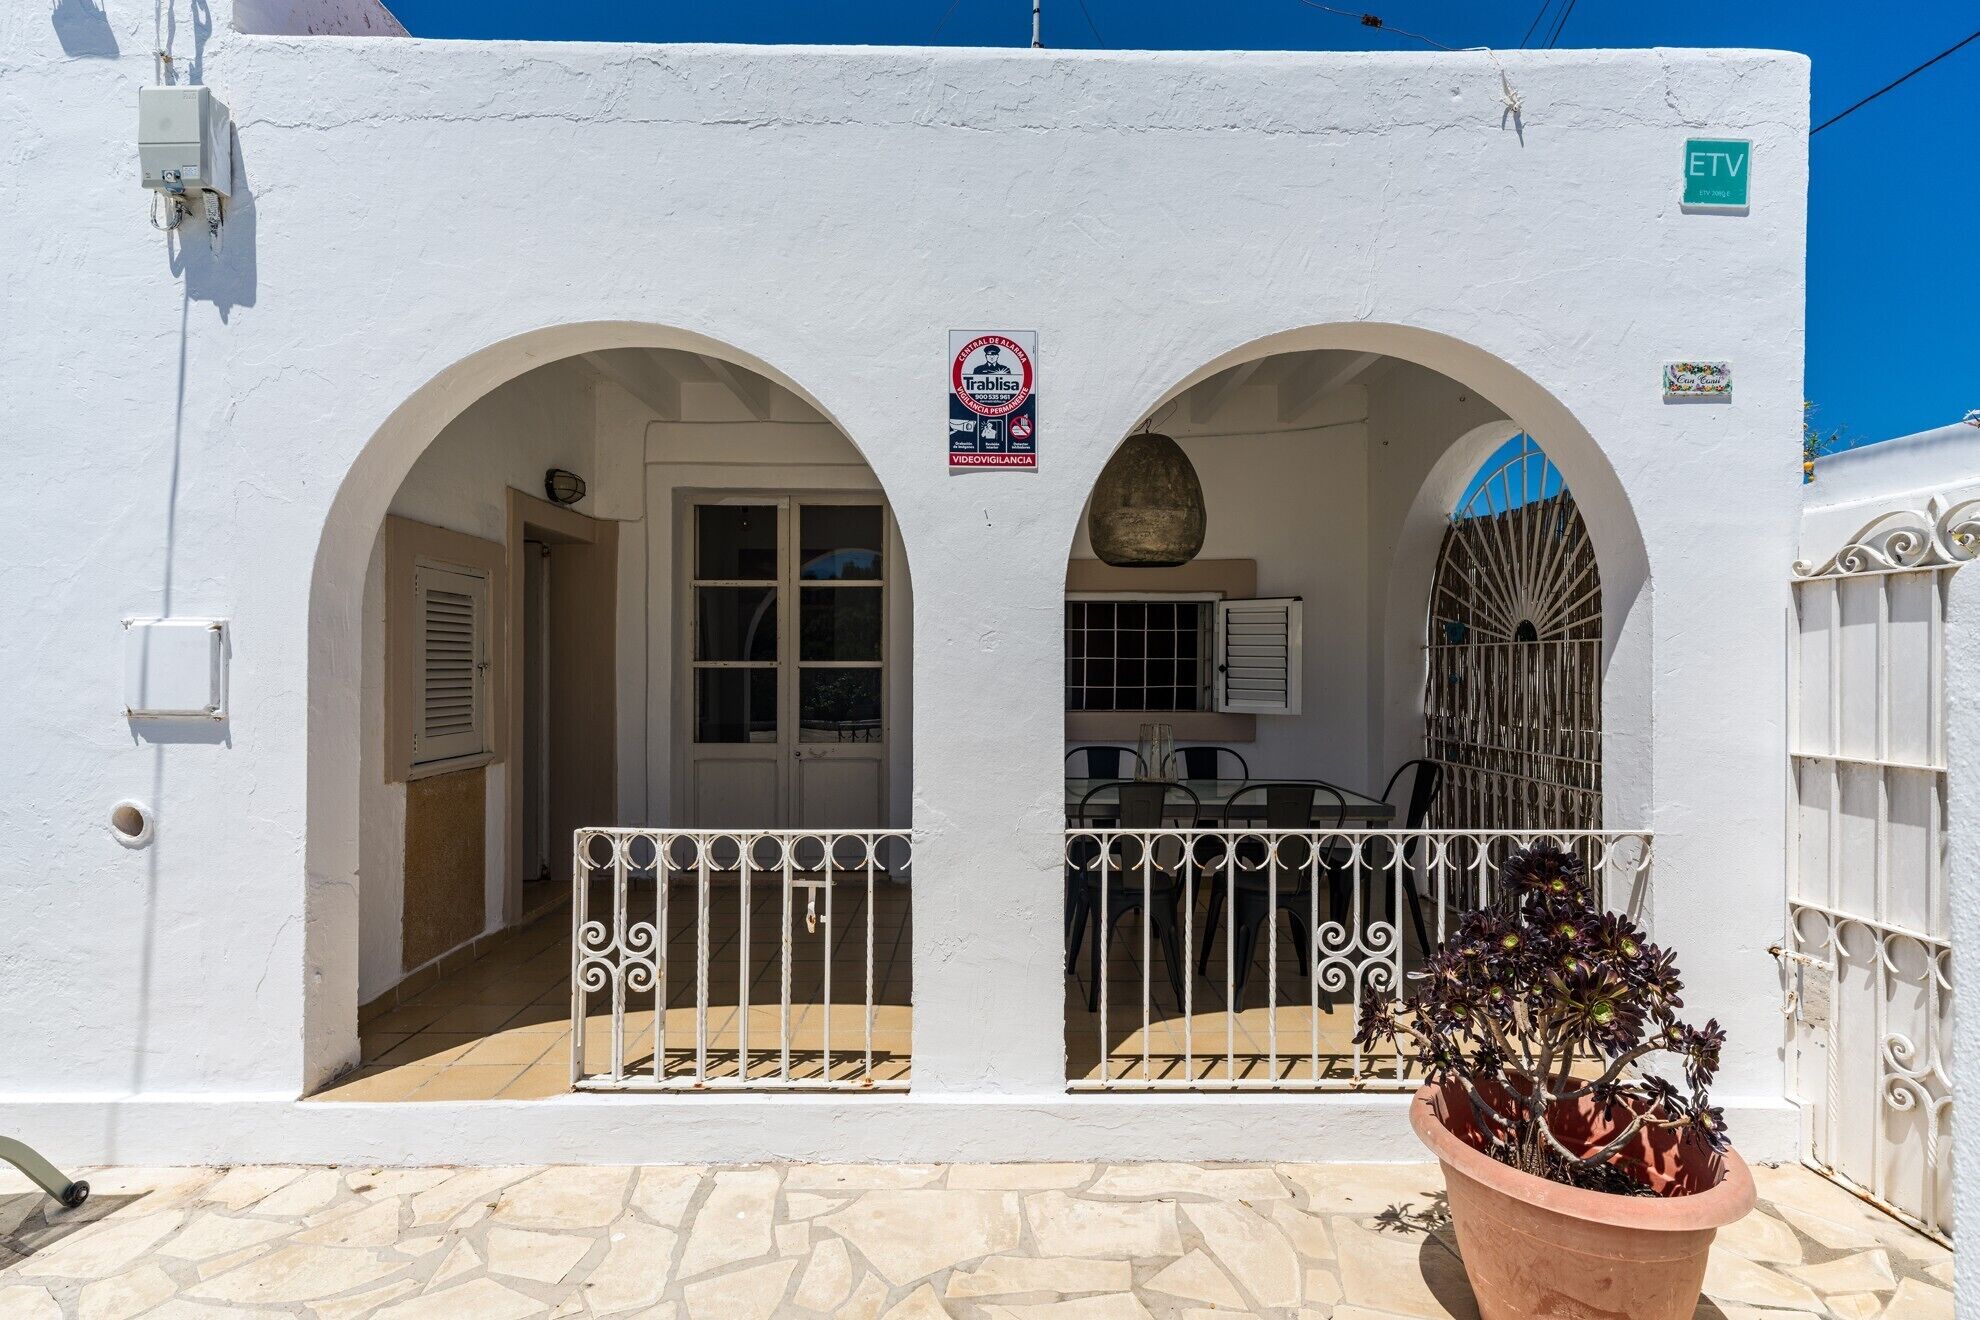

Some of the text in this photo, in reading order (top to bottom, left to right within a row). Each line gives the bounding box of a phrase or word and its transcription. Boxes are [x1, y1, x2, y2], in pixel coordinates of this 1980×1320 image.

[1689, 152, 1744, 177] ETV
[959, 338, 988, 361] CENTRAL
[1000, 338, 1027, 363] ALARMA
[963, 377, 1019, 391] Trablisa
[957, 386, 1029, 414] VIGILANCIA PERMANENTE
[953, 455, 1033, 464] VIDEOVIGILANCIA
